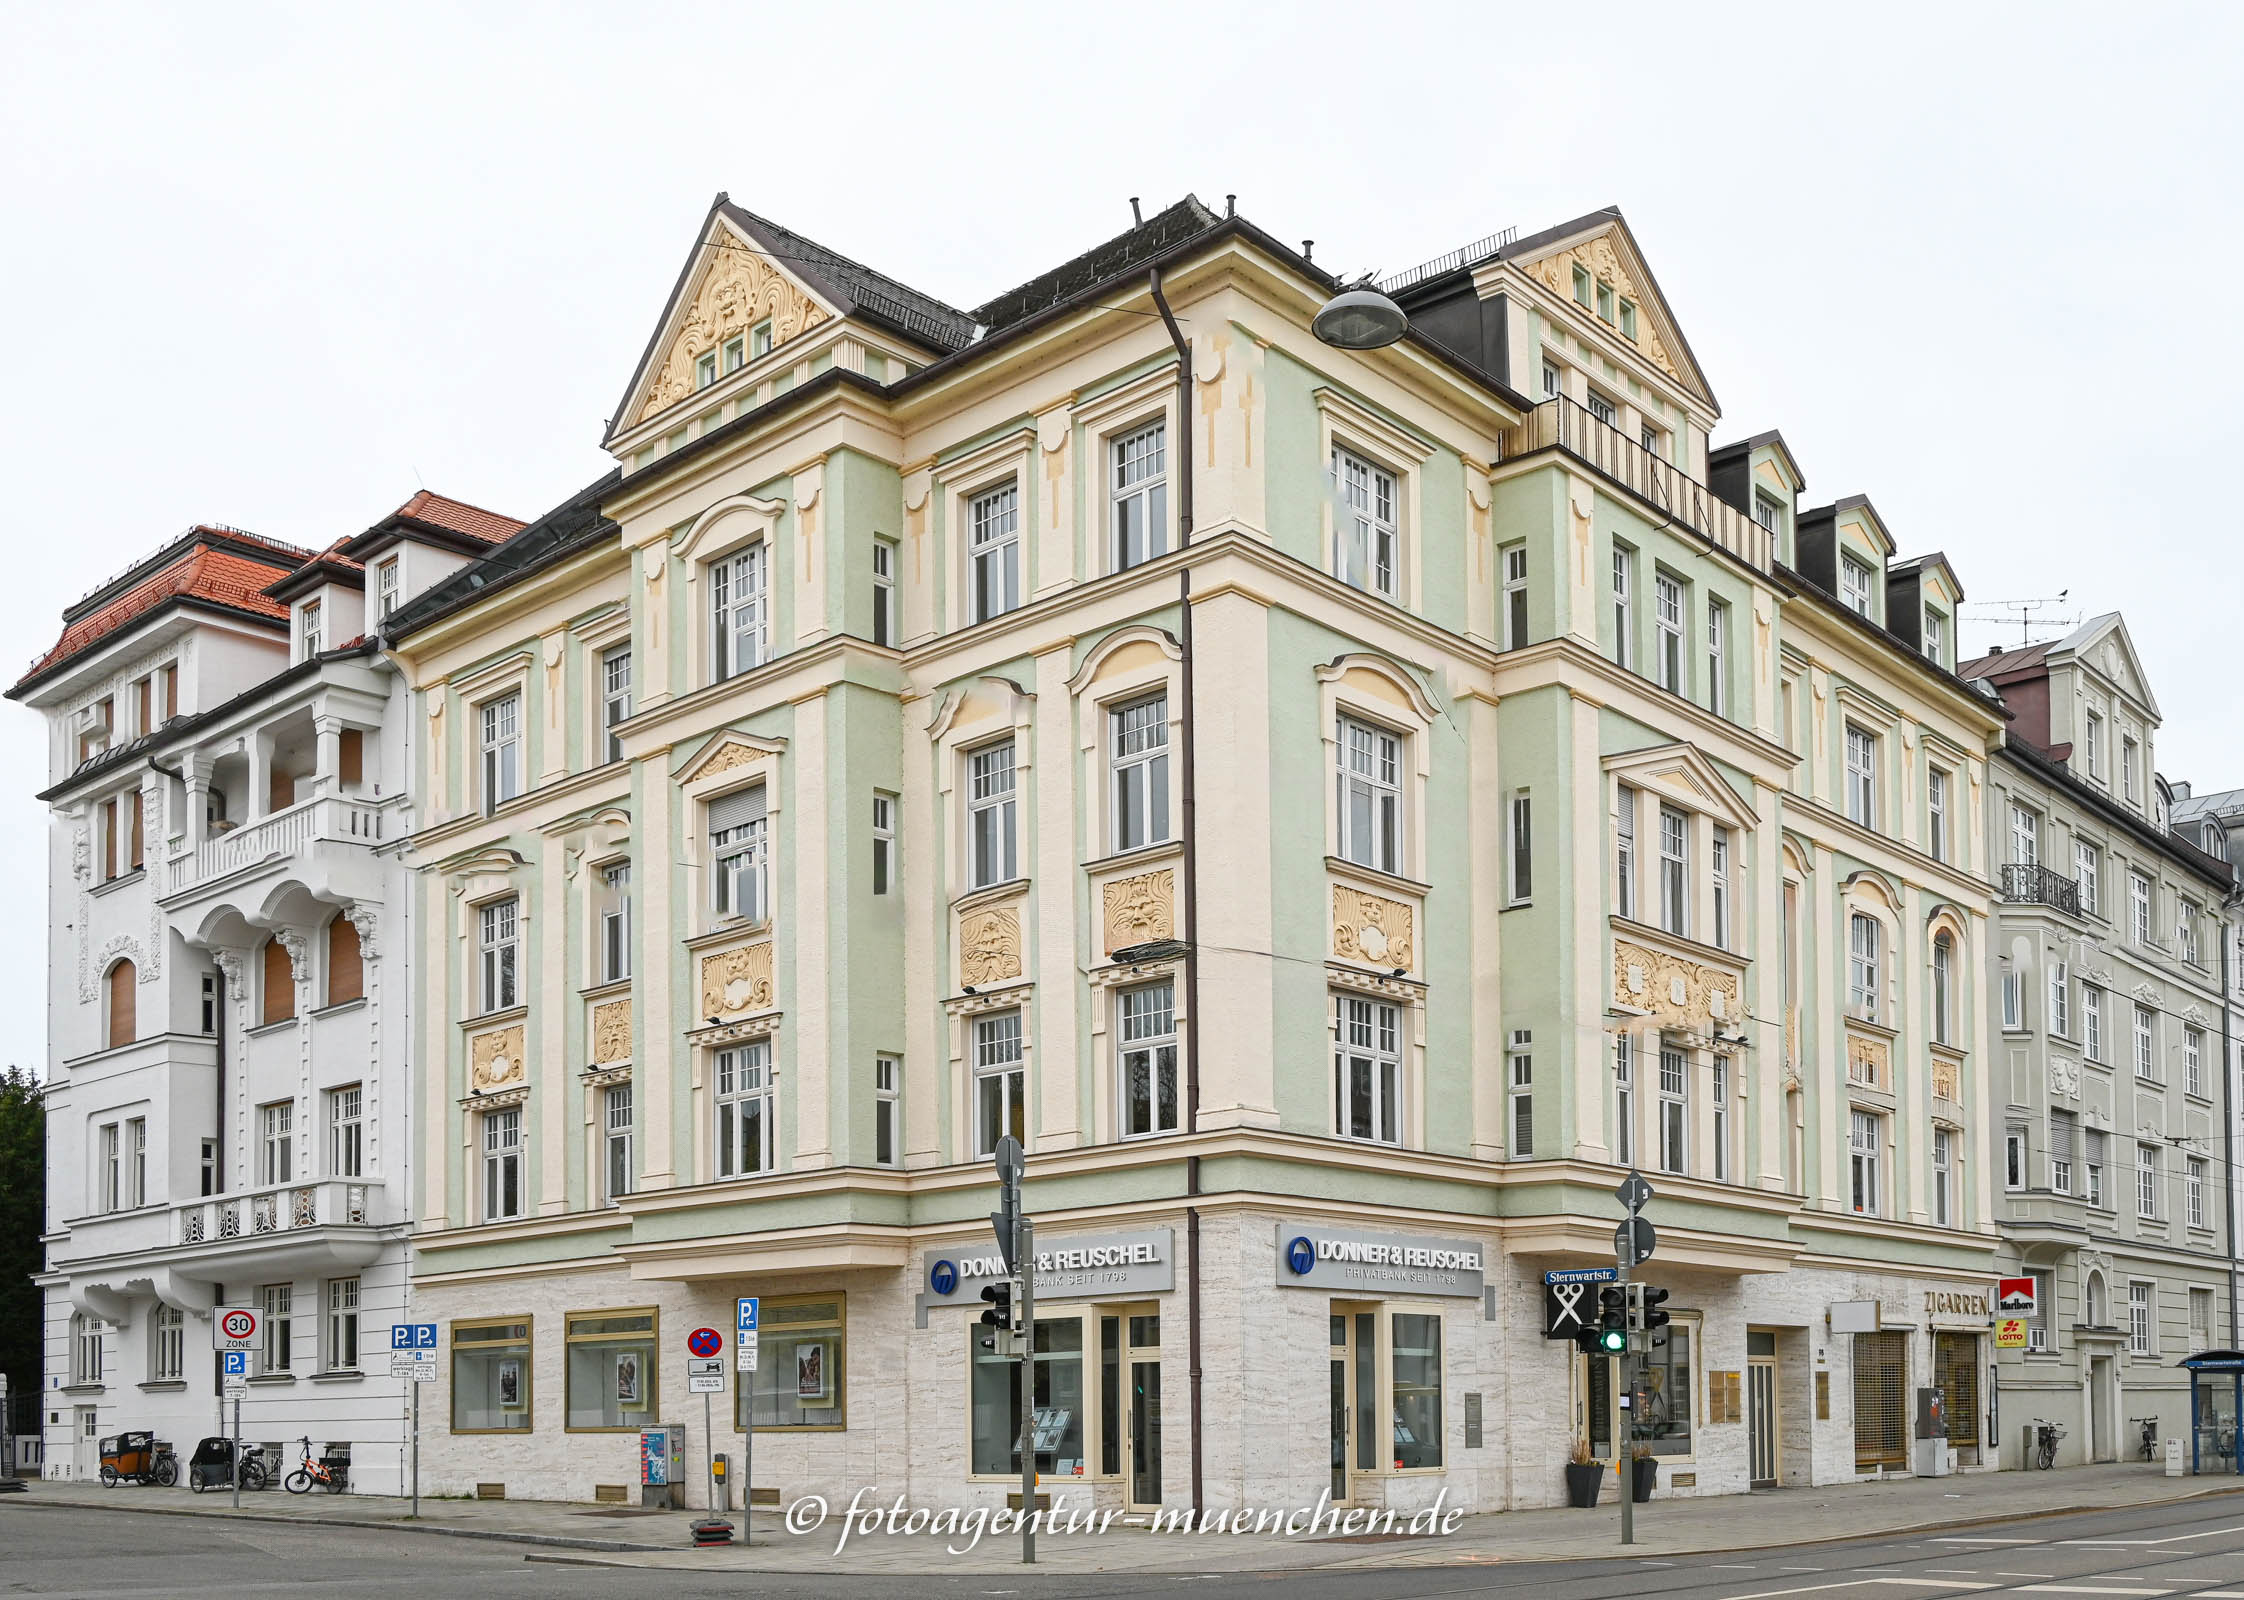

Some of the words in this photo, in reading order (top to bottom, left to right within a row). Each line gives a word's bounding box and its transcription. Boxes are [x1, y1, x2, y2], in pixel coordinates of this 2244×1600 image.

[1067, 1273, 1094, 1285] SEIT
[1100, 1271, 1126, 1283] 1798
[1346, 1267, 1407, 1282] PRIVATBANK
[1411, 1272, 1431, 1283] SEIT
[1435, 1274, 1456, 1285] 1798
[1550, 1271, 1612, 1283] Sternwartstr.
[1924, 1291, 1987, 1316] ZIGARREN
[2000, 1298, 2034, 1310] Marlboro
[229, 1318, 249, 1331] 30
[1998, 1333, 2023, 1341] LOTTO
[226, 1340, 252, 1348] ZONE
